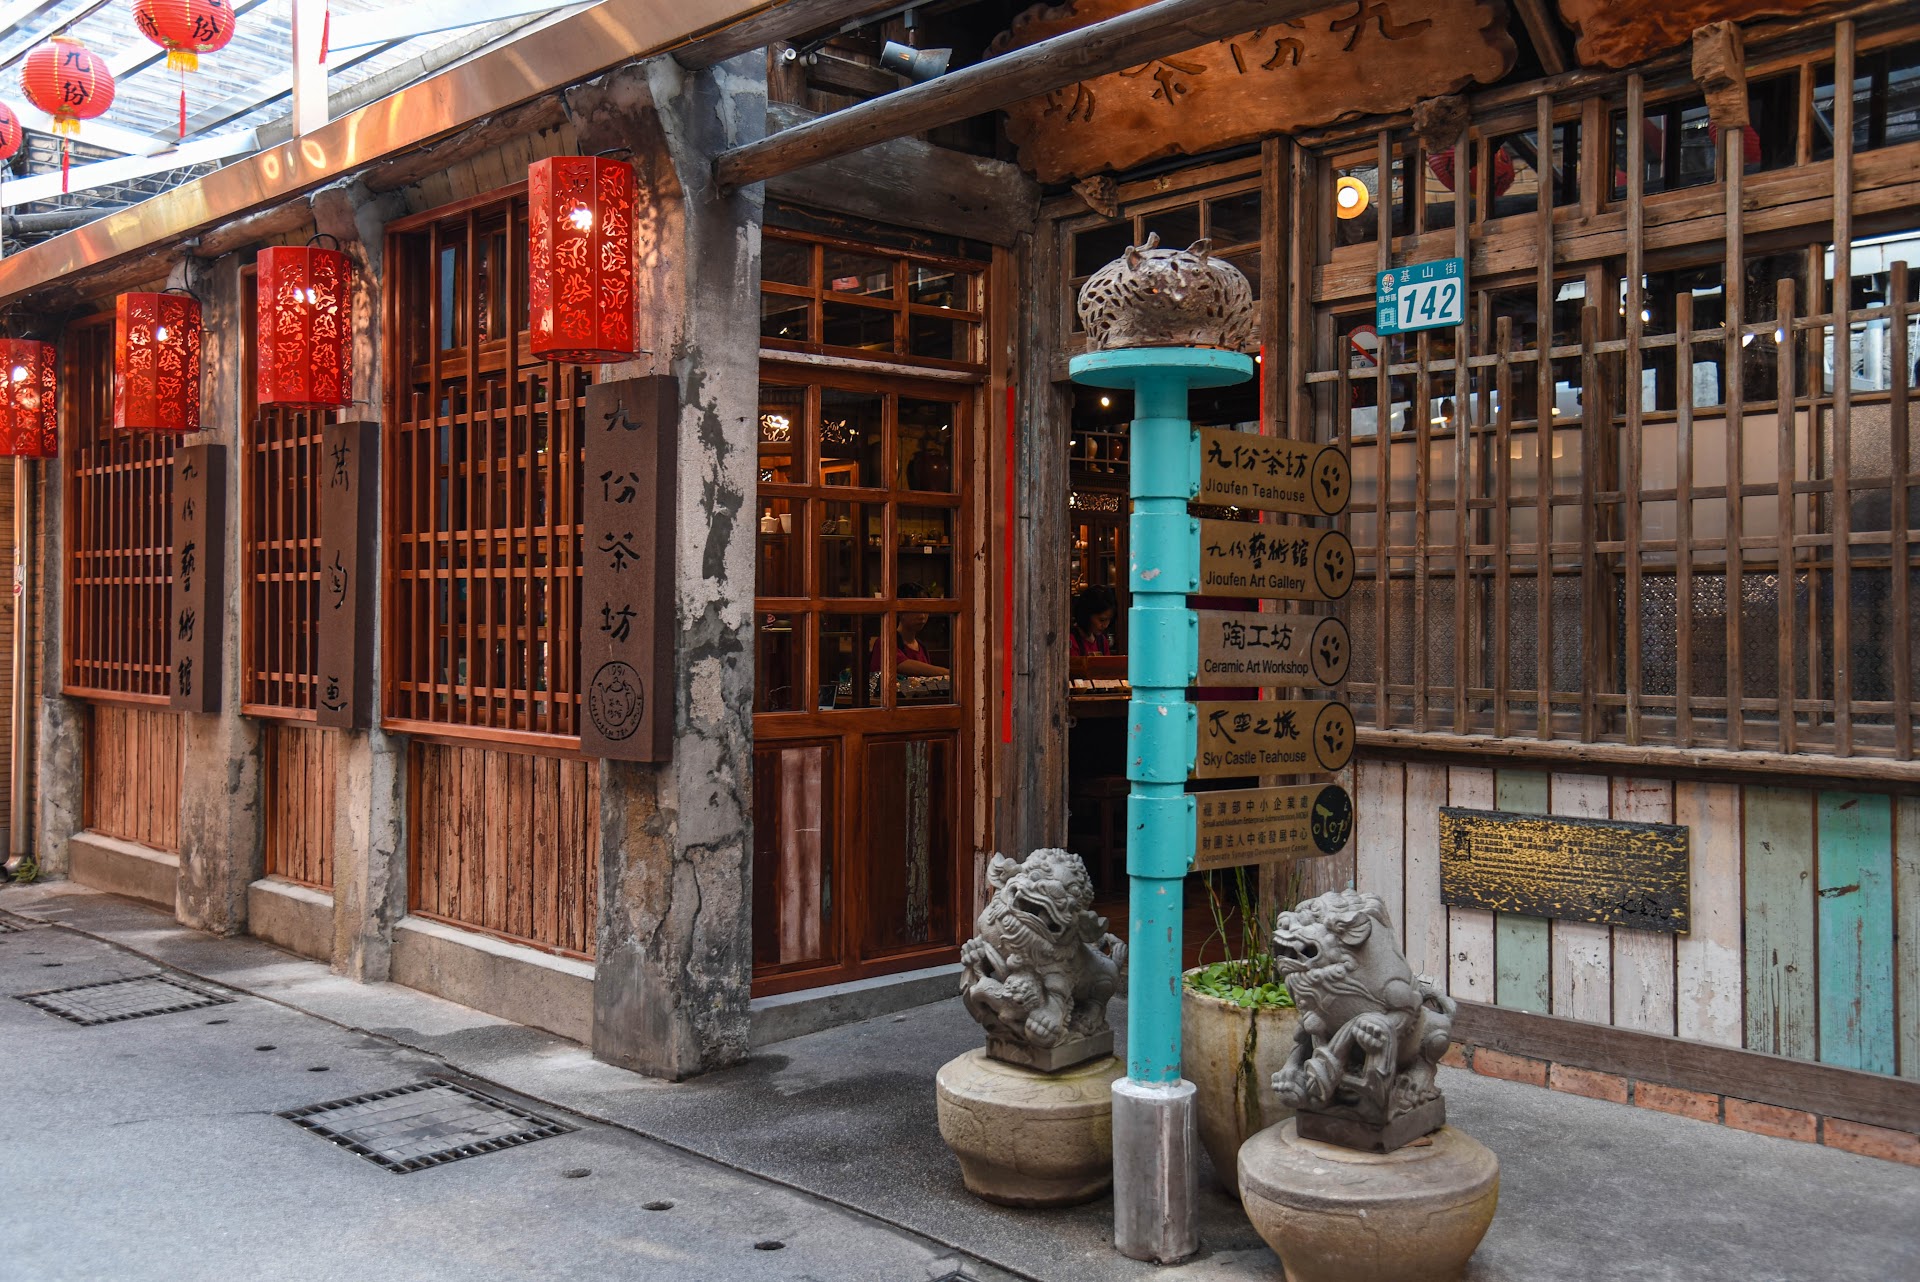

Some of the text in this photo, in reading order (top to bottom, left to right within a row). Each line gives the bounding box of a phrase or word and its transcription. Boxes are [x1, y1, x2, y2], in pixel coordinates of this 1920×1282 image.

[63, 51, 91, 105] 九份
[1400, 262, 1457, 283] 基山街
[1403, 283, 1457, 324] 142
[1208, 440, 1308, 479] 九份茶坊
[1205, 478, 1305, 502] Jioufen Teahouse
[598, 400, 642, 643] 九份茶坊
[1206, 532, 1310, 570] 九份藝術館
[1205, 571, 1306, 592] Jioufen Art Gallery
[1222, 620, 1293, 650] 陶工坊
[1204, 658, 1309, 677] Ceramic Art Workshop
[1209, 709, 1300, 744] 天空之城
[1203, 750, 1307, 769] Sky Castle Teahouse
